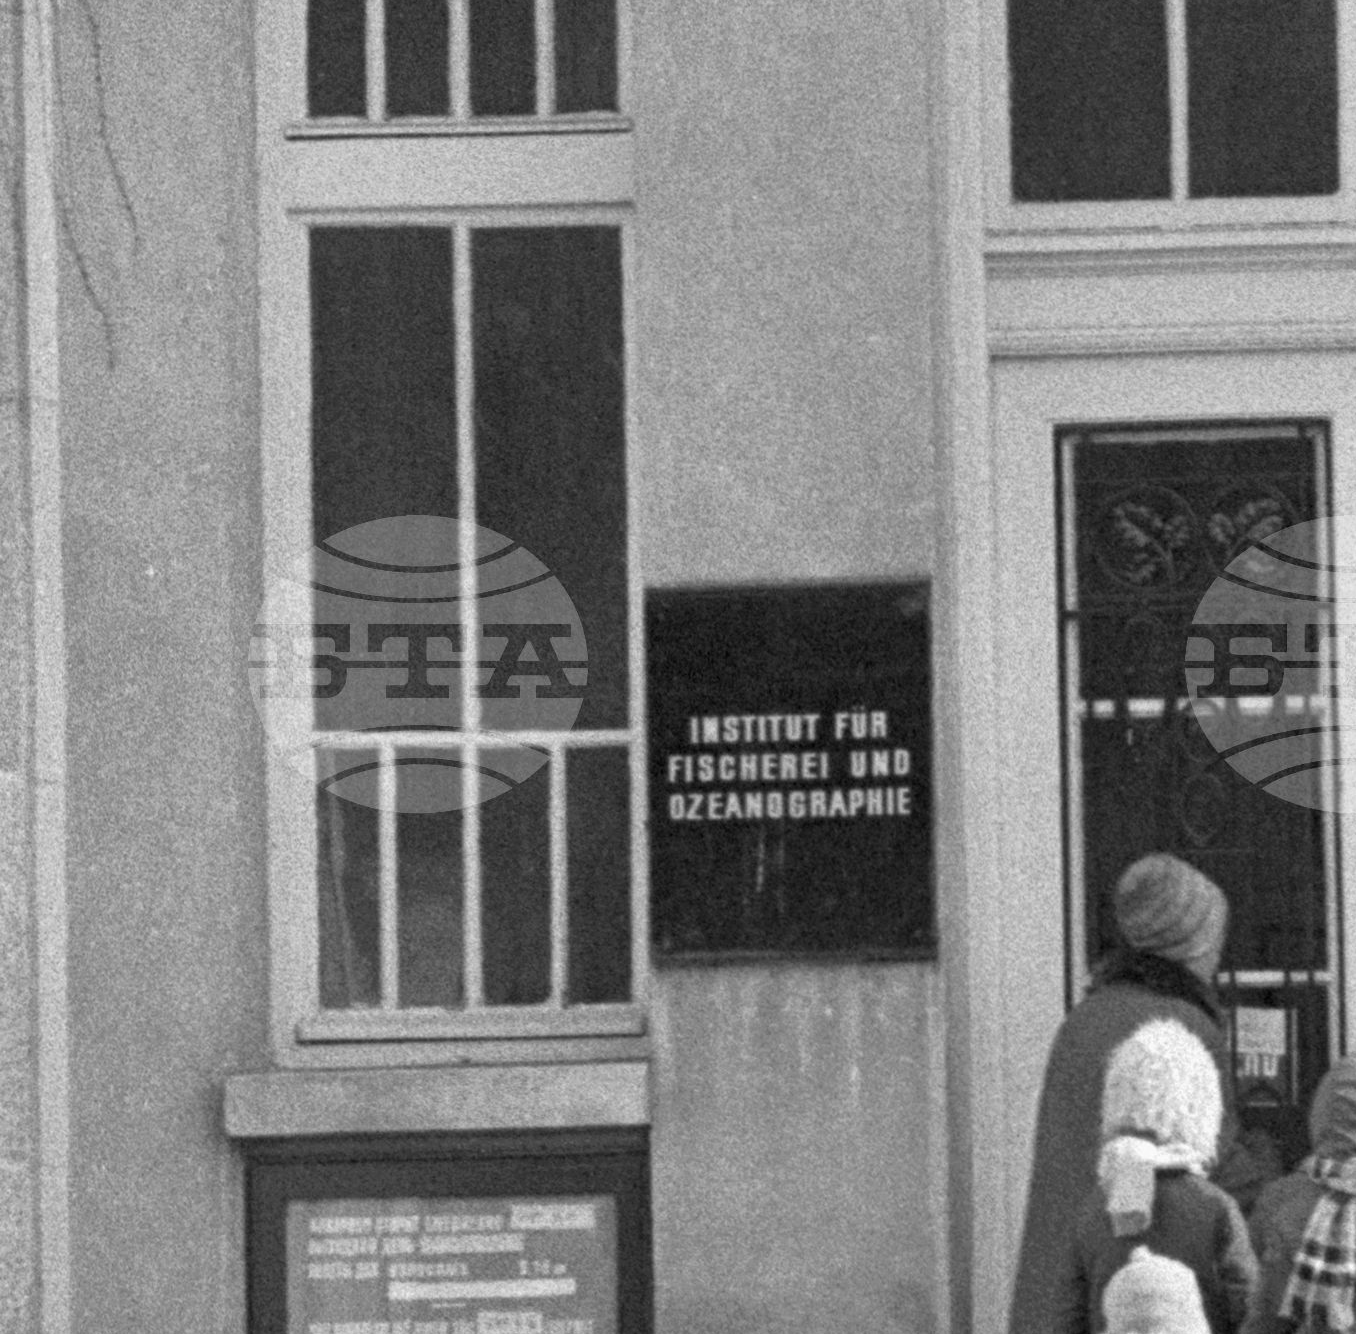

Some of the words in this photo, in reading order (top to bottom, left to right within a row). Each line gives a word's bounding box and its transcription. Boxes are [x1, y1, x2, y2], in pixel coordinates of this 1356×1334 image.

[690, 713, 821, 745] INSTITUT
[834, 705, 889, 741] FÜR
[667, 751, 829, 784] FISCHEREI
[850, 748, 911, 779] UND
[668, 786, 912, 820] OZEANOGRAPHIE
